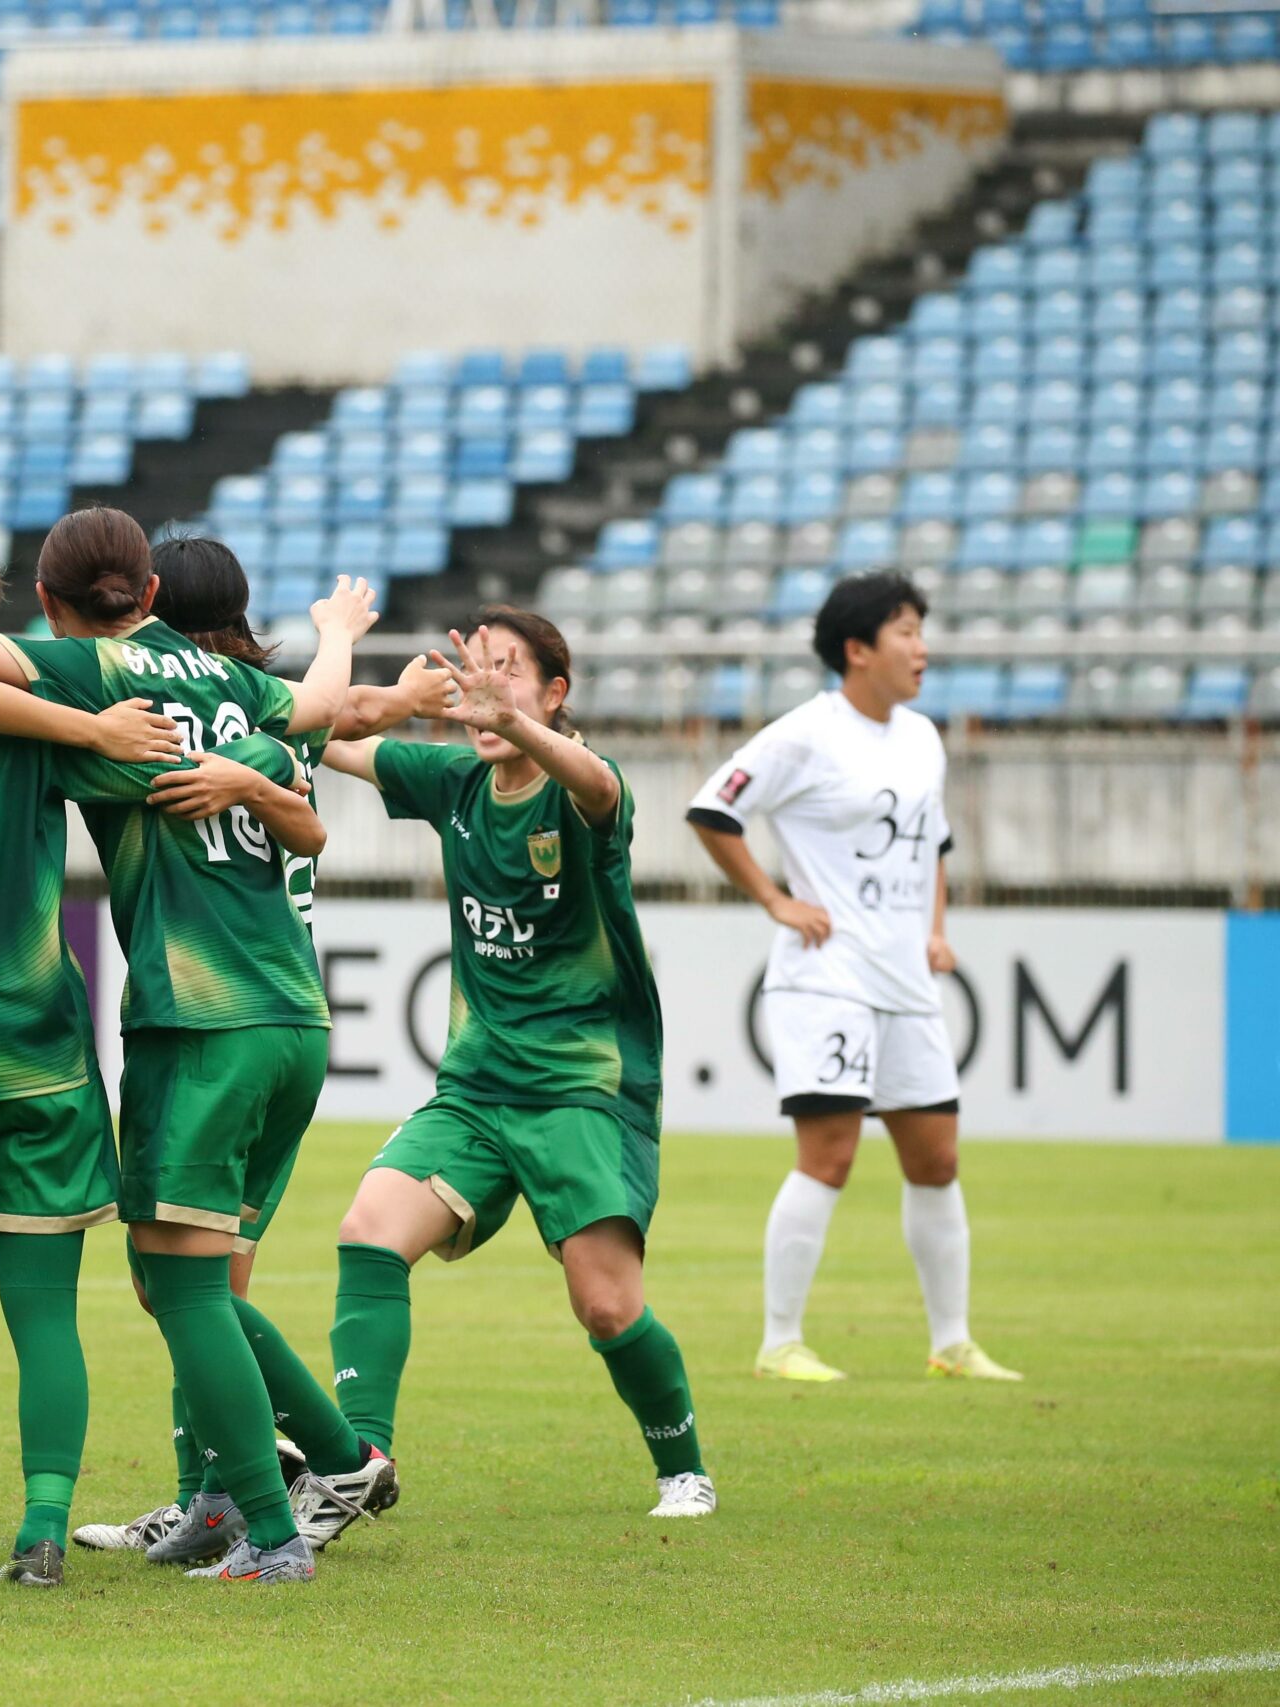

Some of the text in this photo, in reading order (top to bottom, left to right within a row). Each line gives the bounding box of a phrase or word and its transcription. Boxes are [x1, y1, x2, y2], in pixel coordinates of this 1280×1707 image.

[855, 789, 927, 862] 34
[513, 946, 534, 959] TV
[818, 1032, 871, 1084] 34
